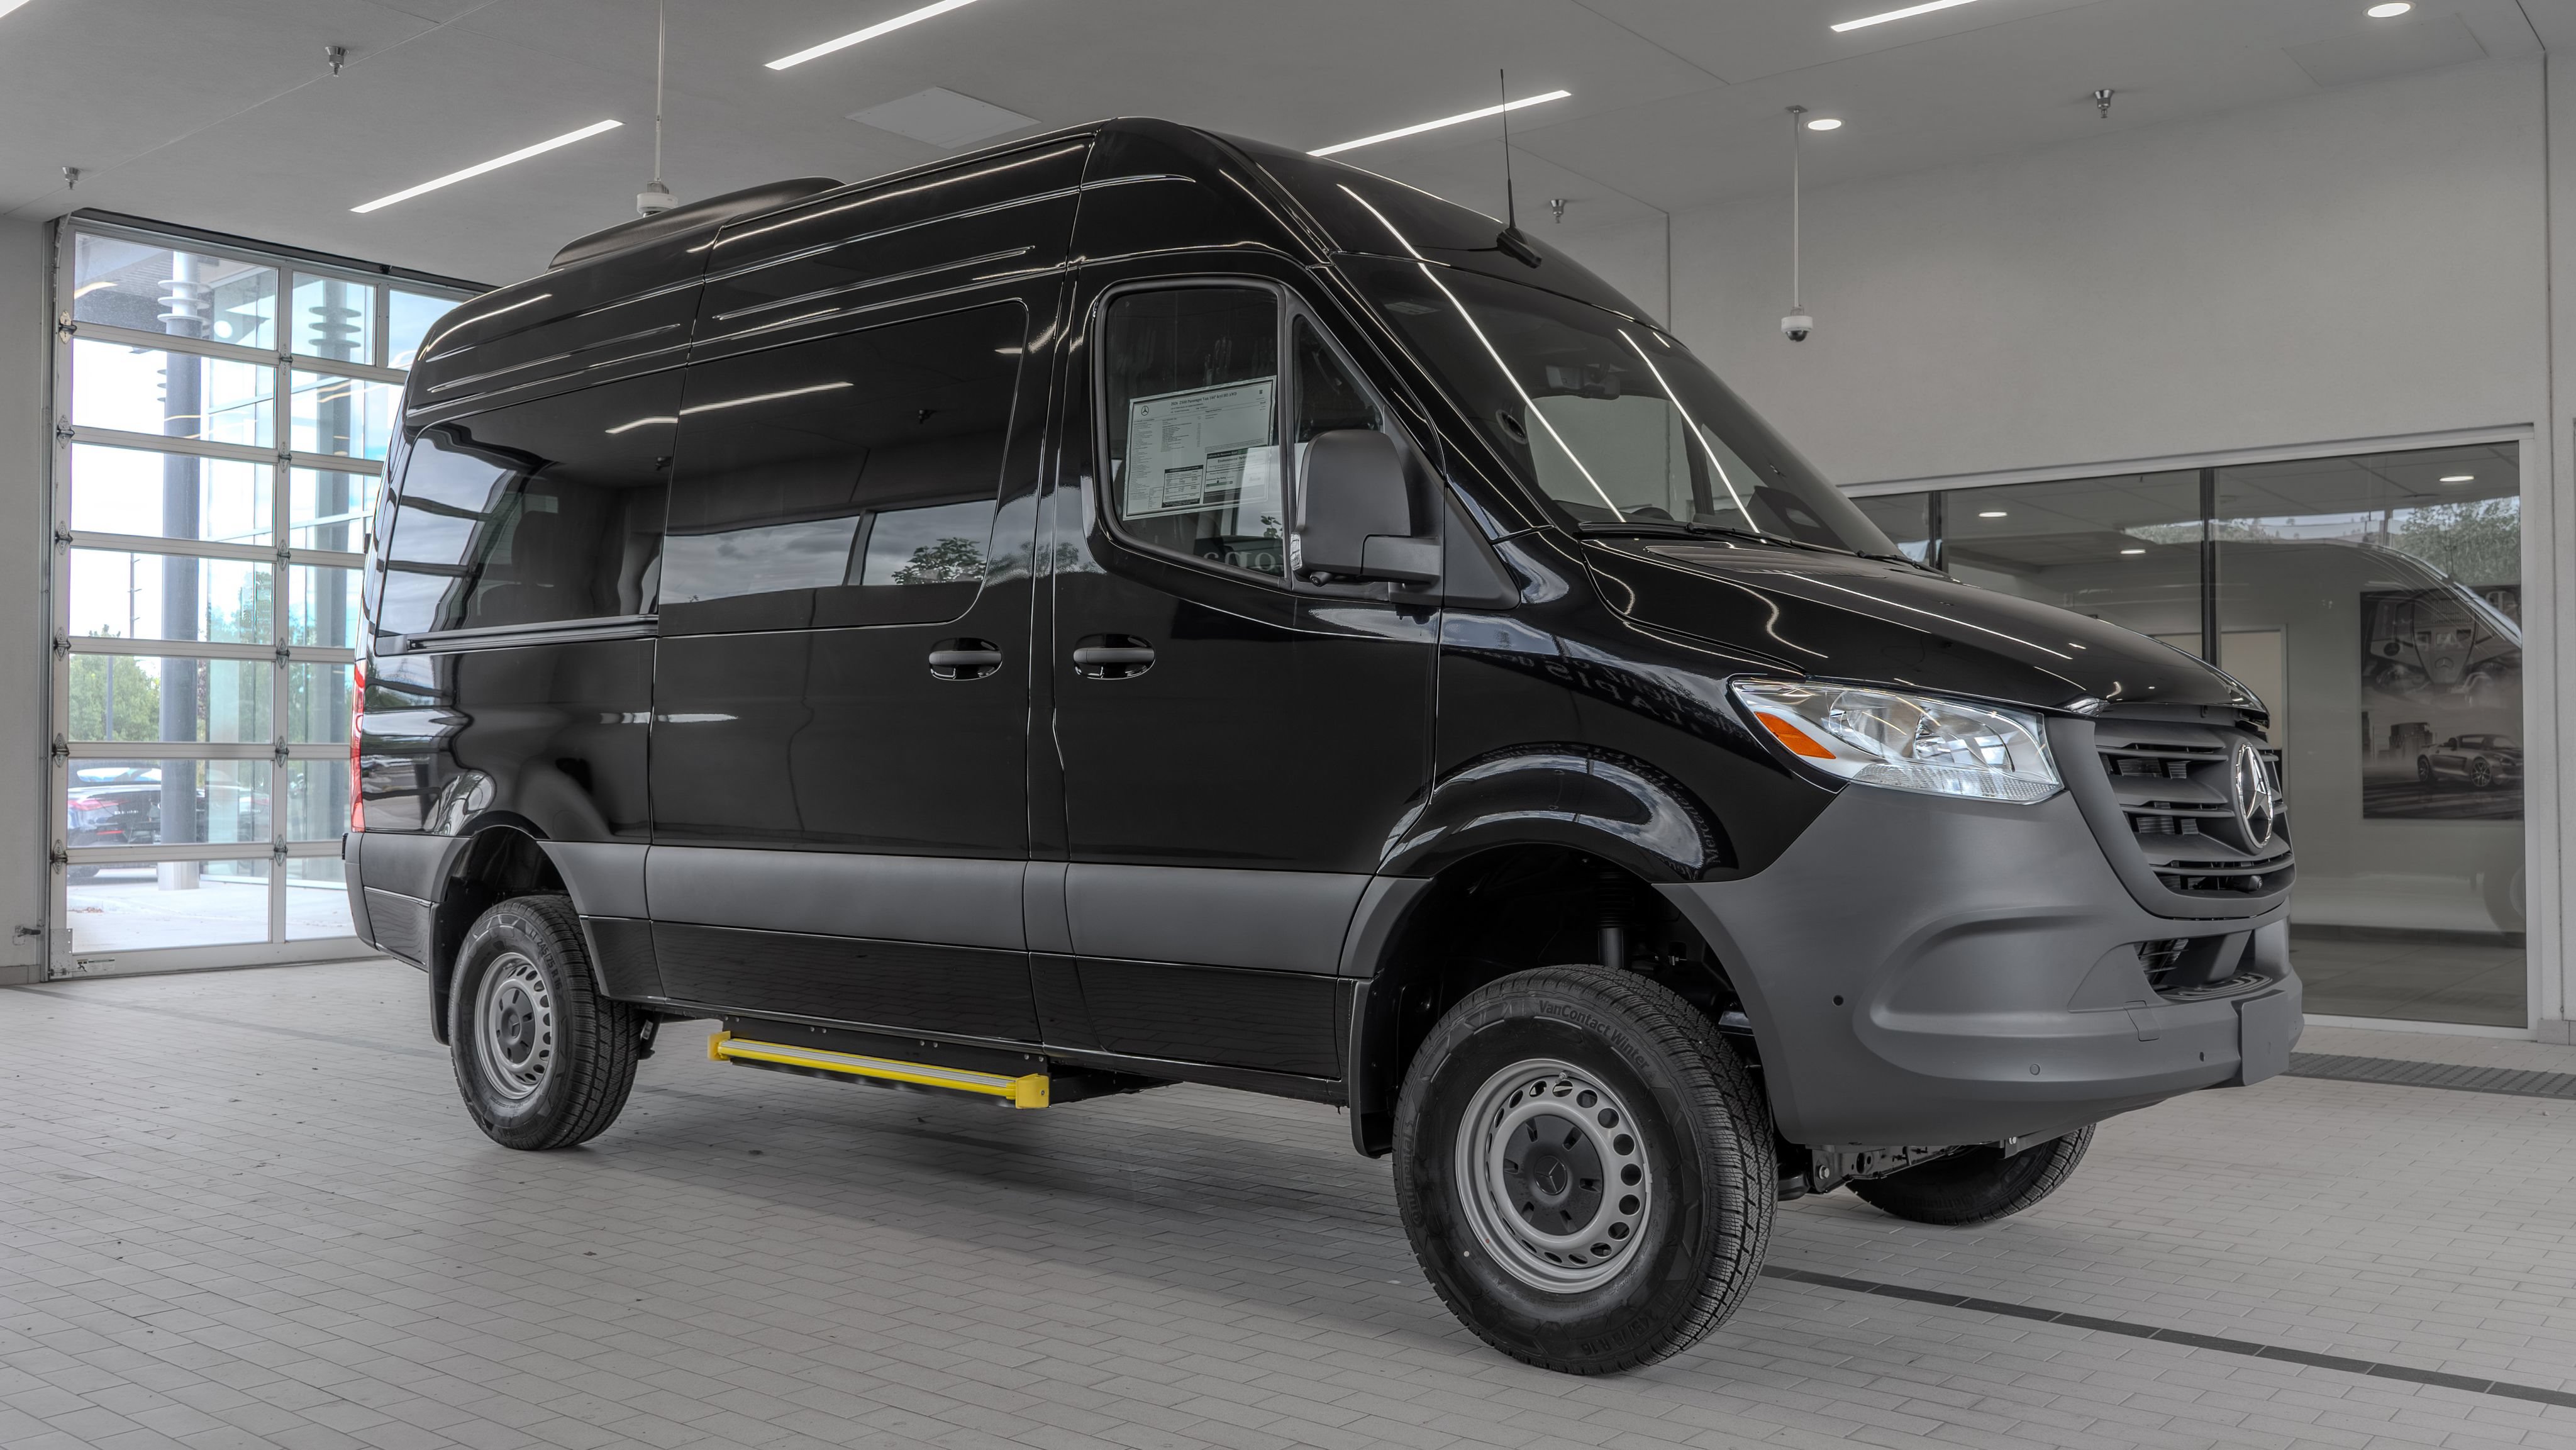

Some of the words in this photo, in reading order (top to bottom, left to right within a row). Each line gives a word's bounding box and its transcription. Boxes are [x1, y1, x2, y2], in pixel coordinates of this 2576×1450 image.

[536, 938, 556, 968] 245/75
[1540, 1000, 1611, 1037] VanContact
[1611, 1029, 1650, 1069] Winter
